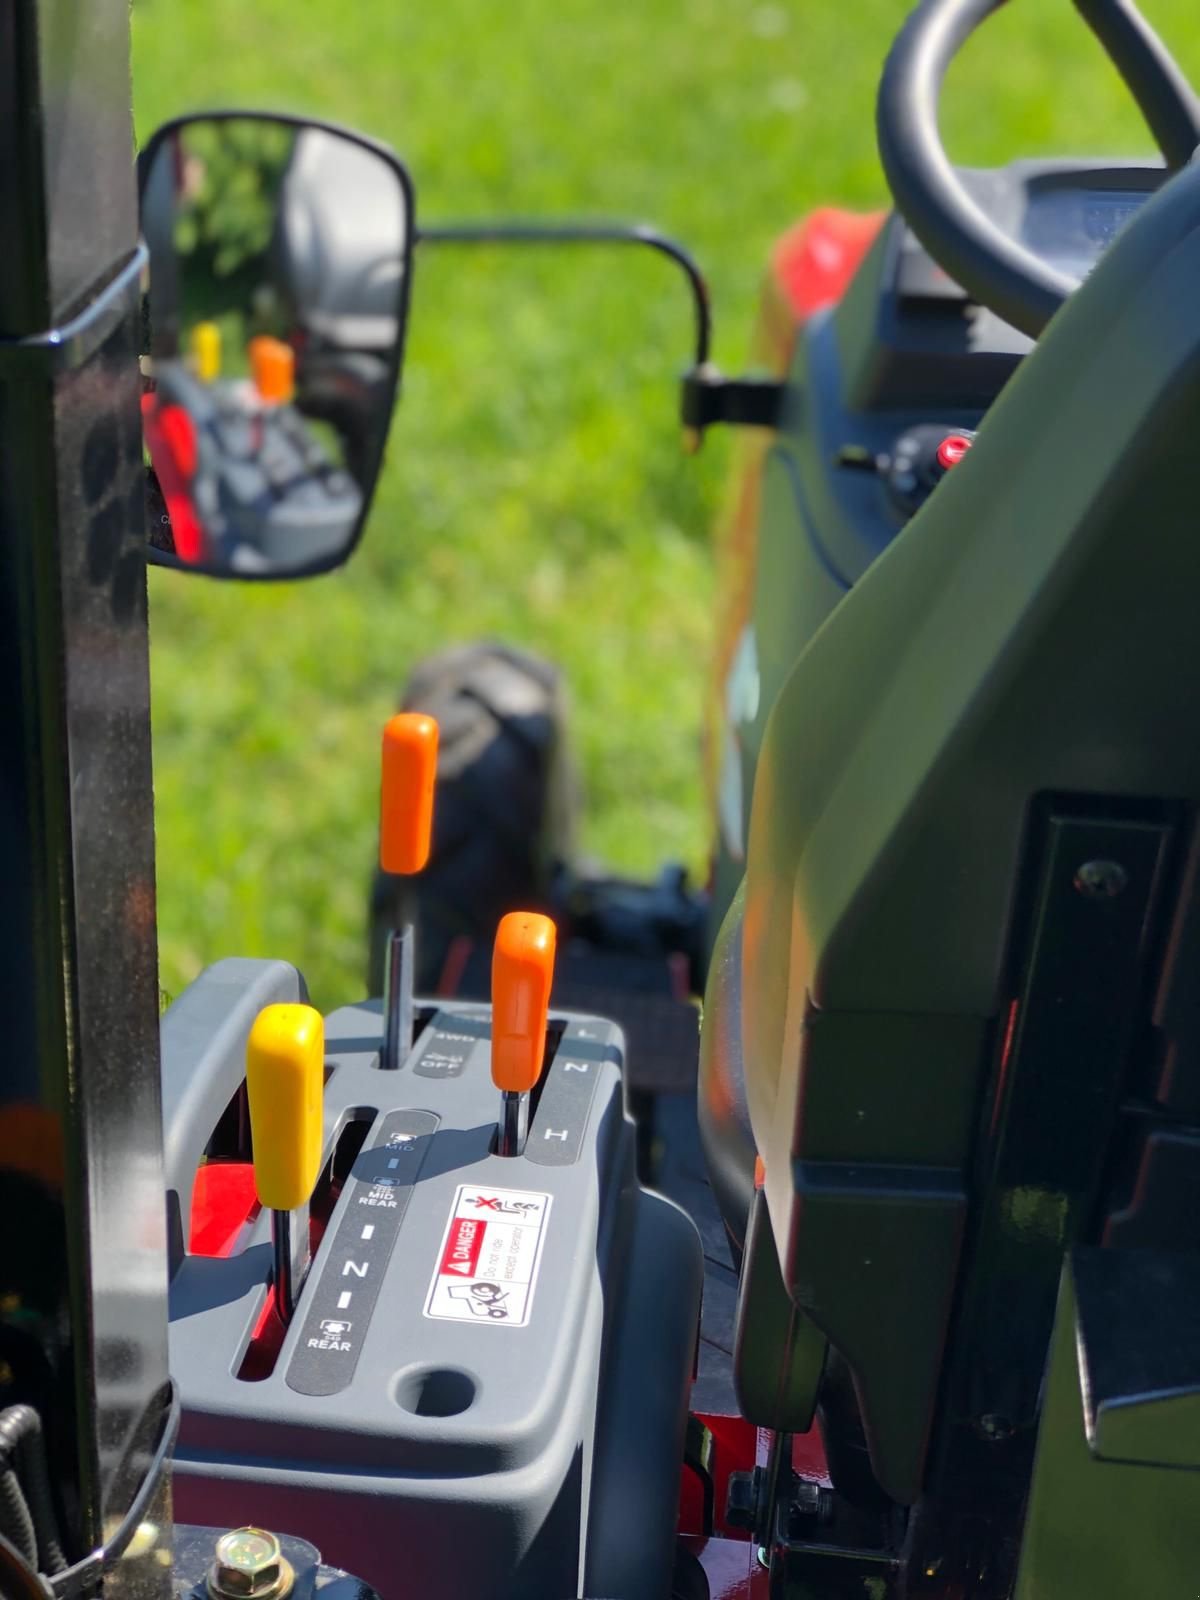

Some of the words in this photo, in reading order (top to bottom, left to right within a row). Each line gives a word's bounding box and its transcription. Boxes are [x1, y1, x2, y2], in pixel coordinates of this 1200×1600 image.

[420, 1060, 459, 1069] OFF
[564, 1062, 589, 1072] N
[544, 1128, 568, 1141] H
[385, 1143, 414, 1152] MID
[368, 1191, 394, 1201] MID
[359, 1197, 398, 1208] REAR
[453, 1221, 478, 1260] DANGER
[342, 1261, 369, 1278] N
[307, 1338, 352, 1352] REAR
